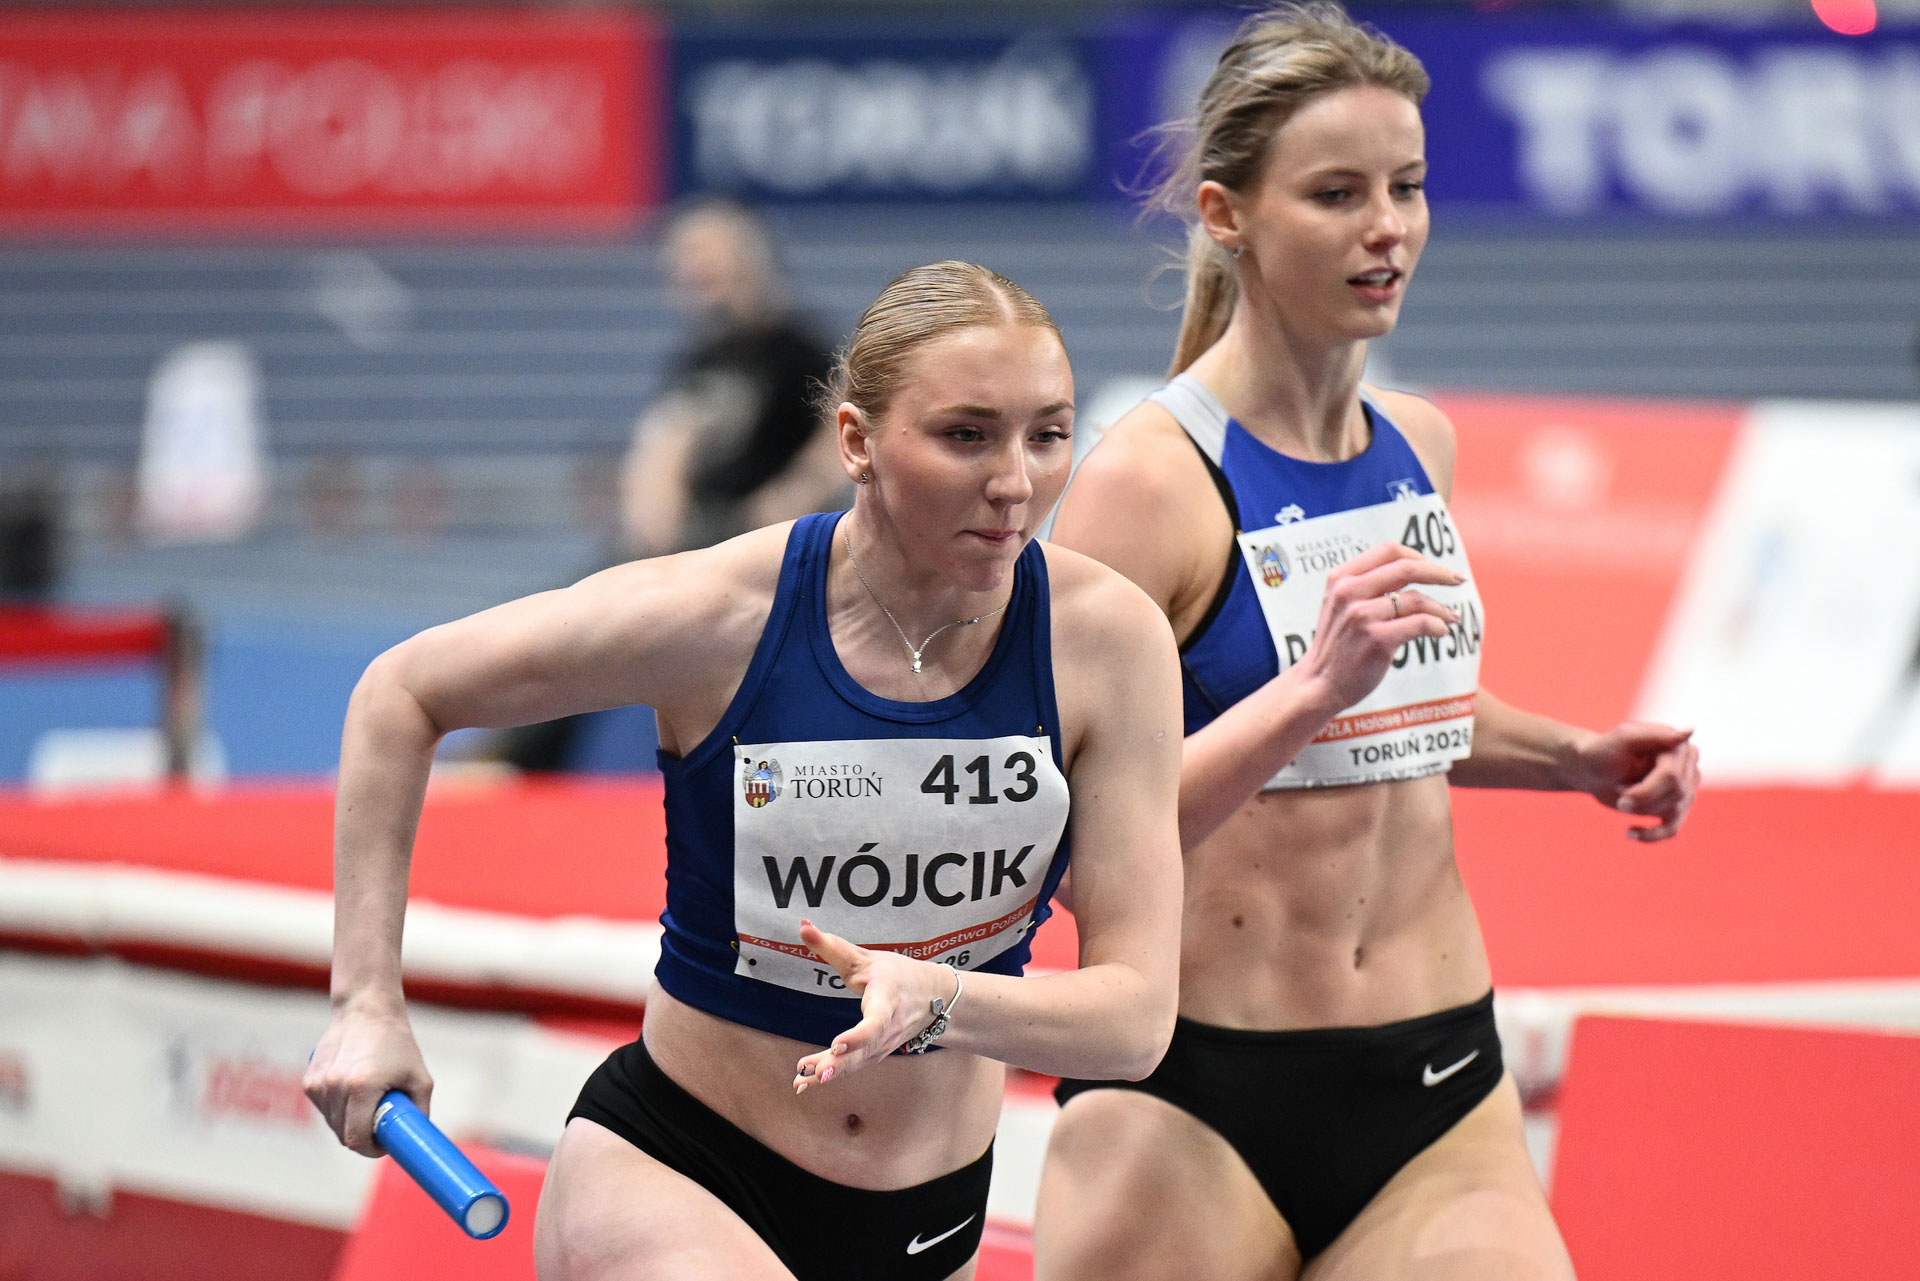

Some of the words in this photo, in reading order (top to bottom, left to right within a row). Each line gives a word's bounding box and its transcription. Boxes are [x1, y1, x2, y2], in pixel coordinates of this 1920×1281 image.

[1400, 510, 1455, 558] 405
[794, 764, 863, 776] MIASTO
[1350, 732, 1420, 766] TORUŃ
[790, 772, 883, 799] TORUŃ
[920, 750, 1039, 805] 413
[762, 842, 1036, 909] WÓJCIK
[779, 945, 819, 960] PZLA
[893, 927, 986, 960] Mistrzostwa
[989, 903, 1028, 933] Polski
